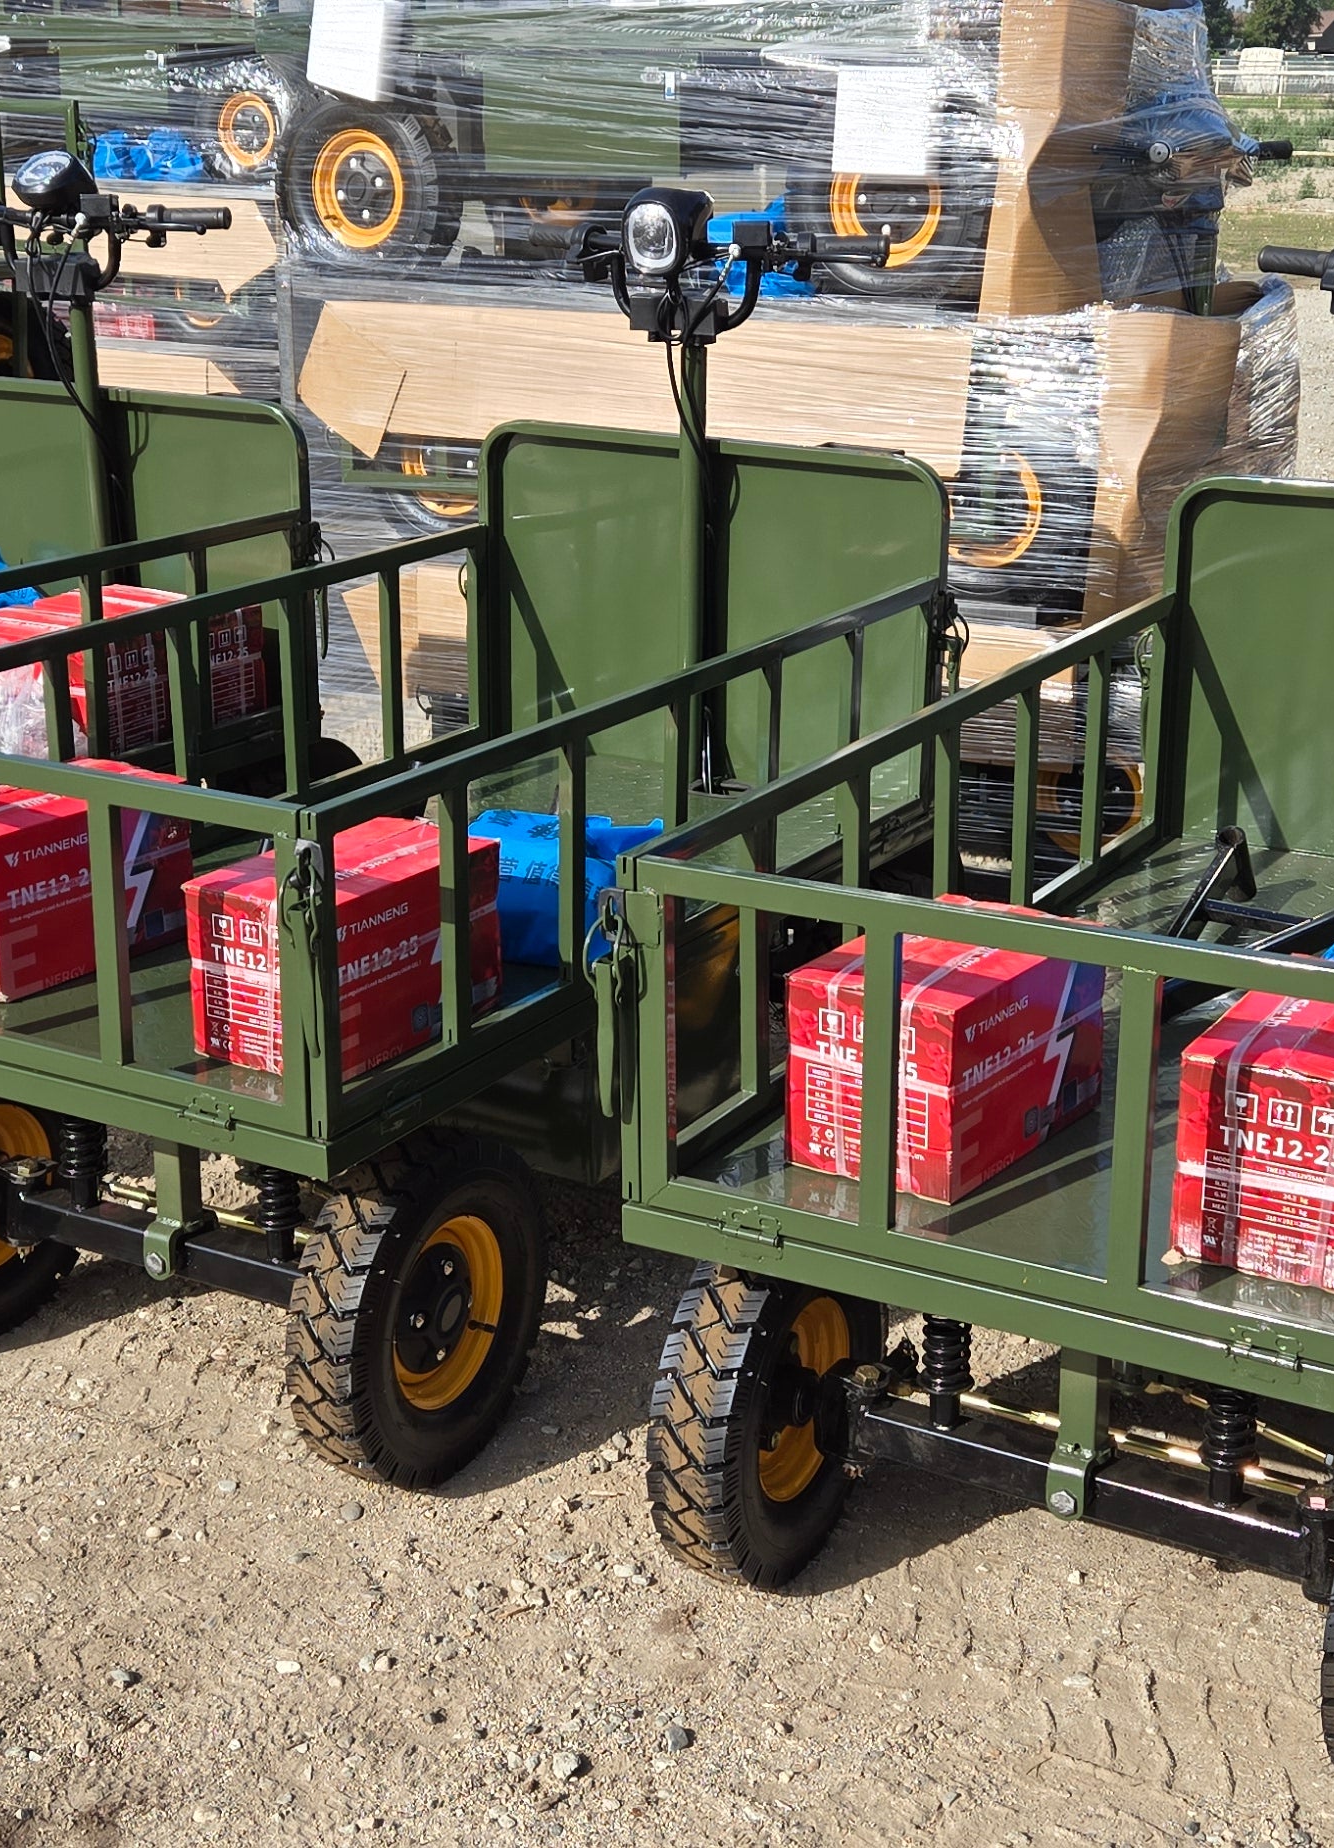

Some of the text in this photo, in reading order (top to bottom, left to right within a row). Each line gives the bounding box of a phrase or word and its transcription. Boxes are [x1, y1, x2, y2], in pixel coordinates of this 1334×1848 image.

[23, 832, 88, 861] TIANNENG
[350, 902, 409, 935] TIANNENG
[979, 994, 1029, 1034] TIANNENG
